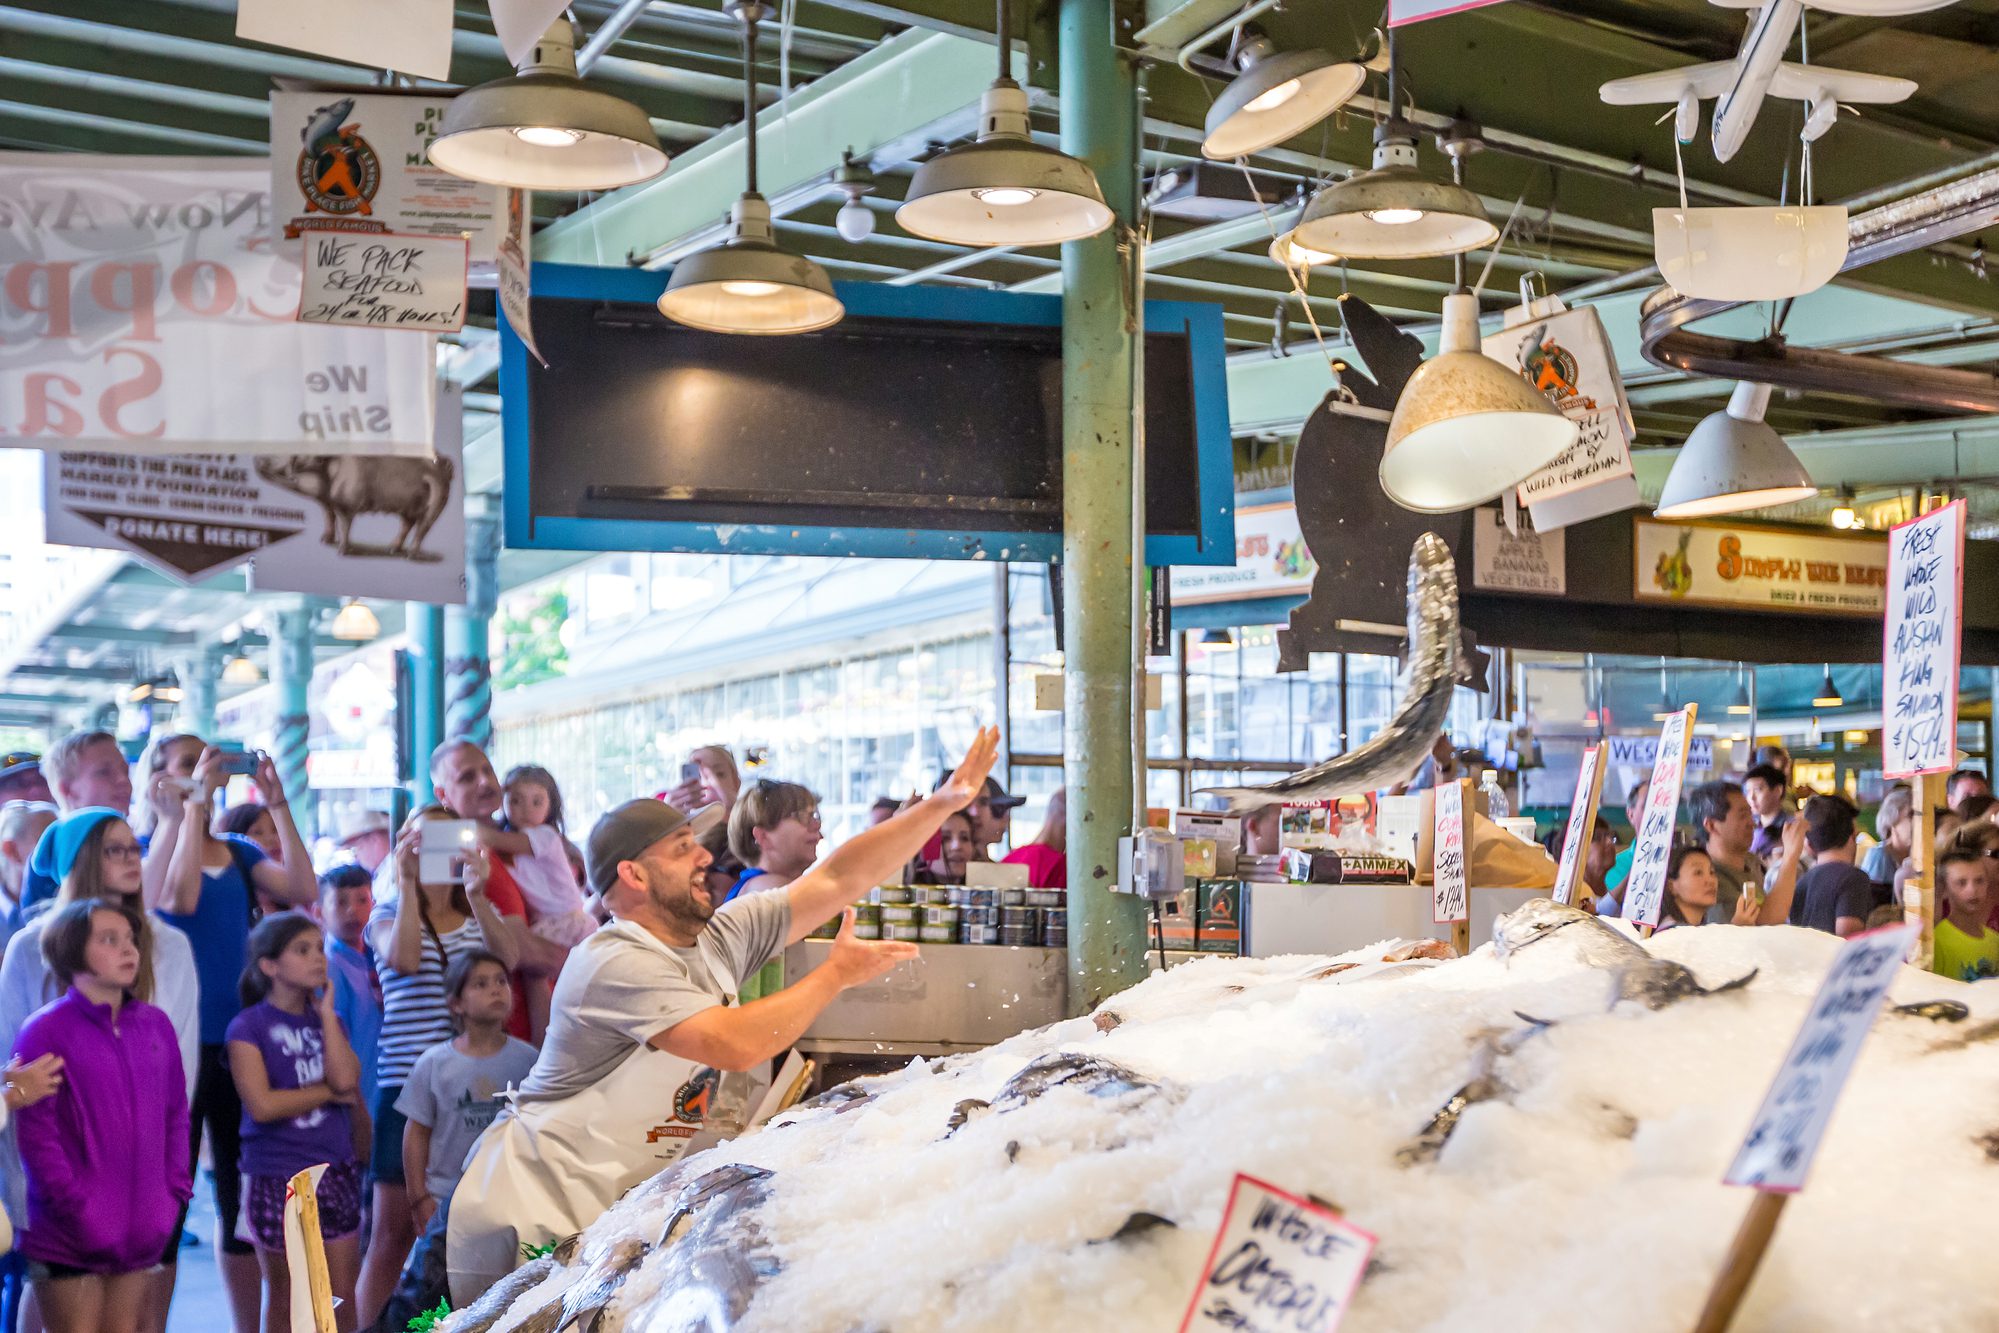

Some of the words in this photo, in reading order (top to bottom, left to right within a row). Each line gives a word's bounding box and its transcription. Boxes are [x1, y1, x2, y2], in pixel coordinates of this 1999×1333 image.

[318, 237, 357, 268] WE
[361, 244, 424, 274] PACK
[141, 457, 168, 474] THE
[105, 515, 198, 544] DONATE
[203, 526, 270, 549] HERE!
[655, 1128, 684, 1137] WORLD
